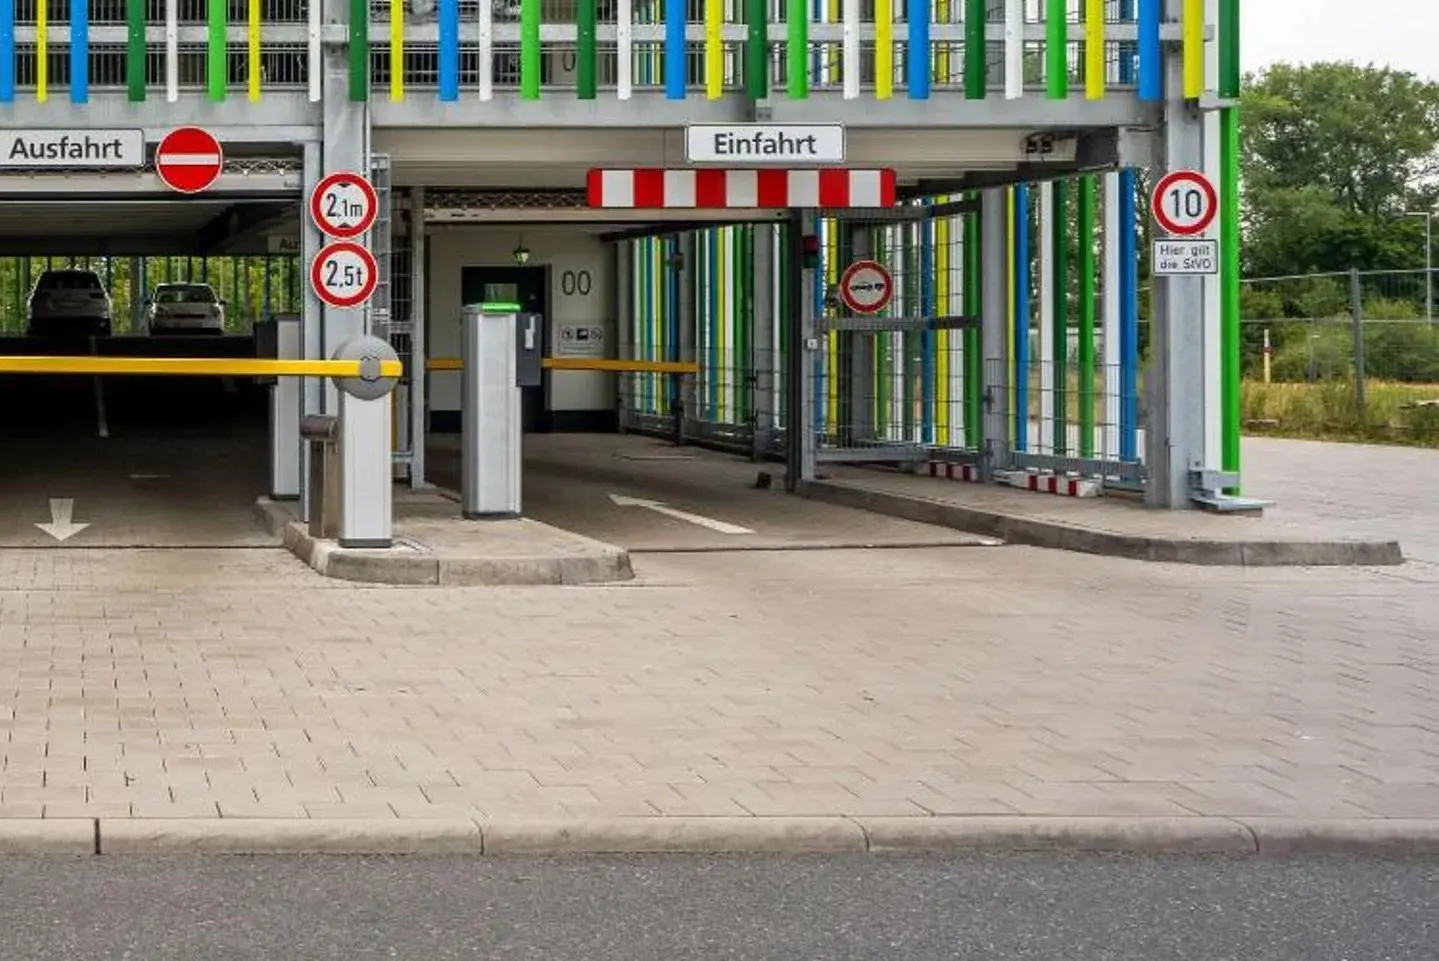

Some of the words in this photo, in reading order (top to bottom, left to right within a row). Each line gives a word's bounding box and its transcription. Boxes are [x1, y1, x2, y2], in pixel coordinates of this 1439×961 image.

[9, 135, 123, 159] Ausfahrt
[714, 131, 817, 154] Einfahrt
[1170, 189, 1202, 217] 10
[1160, 245, 1184, 255] Hier
[1191, 246, 1210, 257] gilt
[1160, 259, 1178, 269] die
[562, 270, 591, 295] 00
